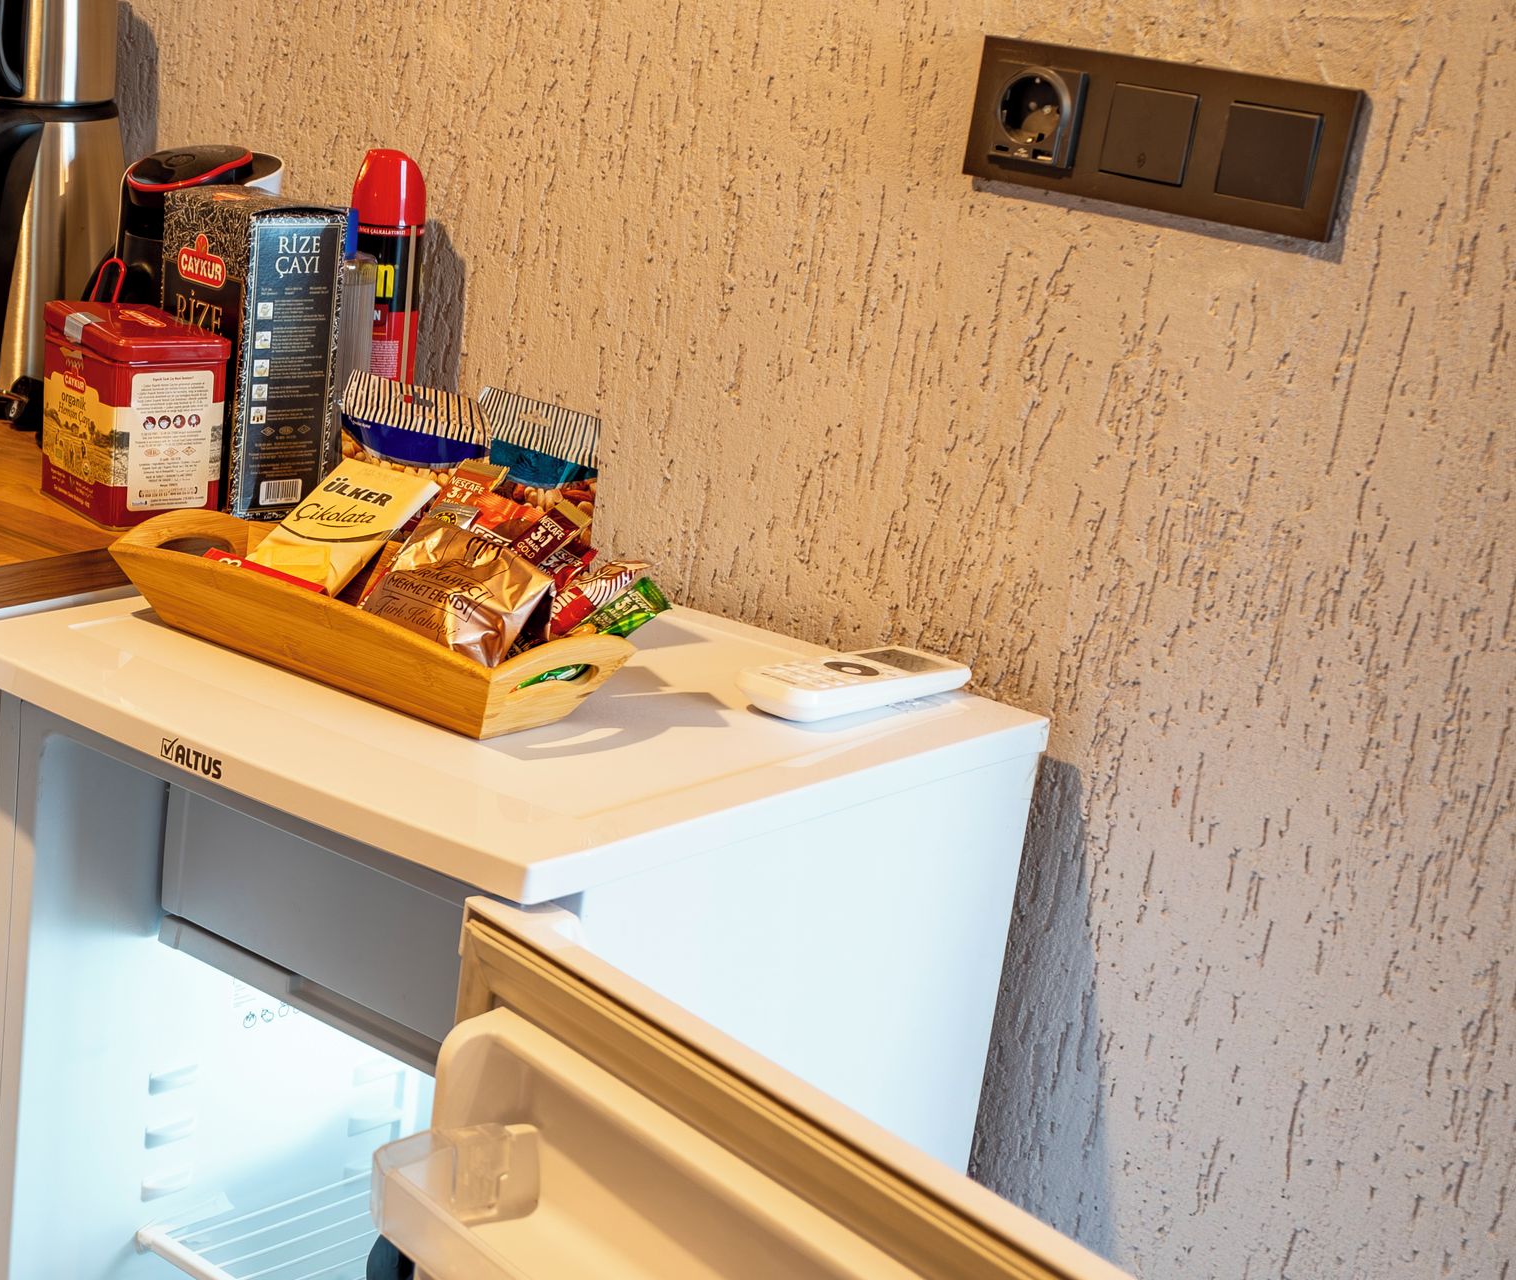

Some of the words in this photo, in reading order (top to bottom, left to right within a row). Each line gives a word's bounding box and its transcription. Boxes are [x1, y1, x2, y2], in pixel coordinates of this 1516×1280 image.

[278, 233, 321, 254] RİZE
[275, 256, 320, 279] ÇAYI
[61, 391, 86, 412] organik
[322, 477, 393, 507] ÜLKER
[292, 503, 377, 524] Çikolata
[516, 541, 537, 560] GOLD
[387, 575, 430, 598] MEHMET
[174, 744, 222, 780] ALTUS
